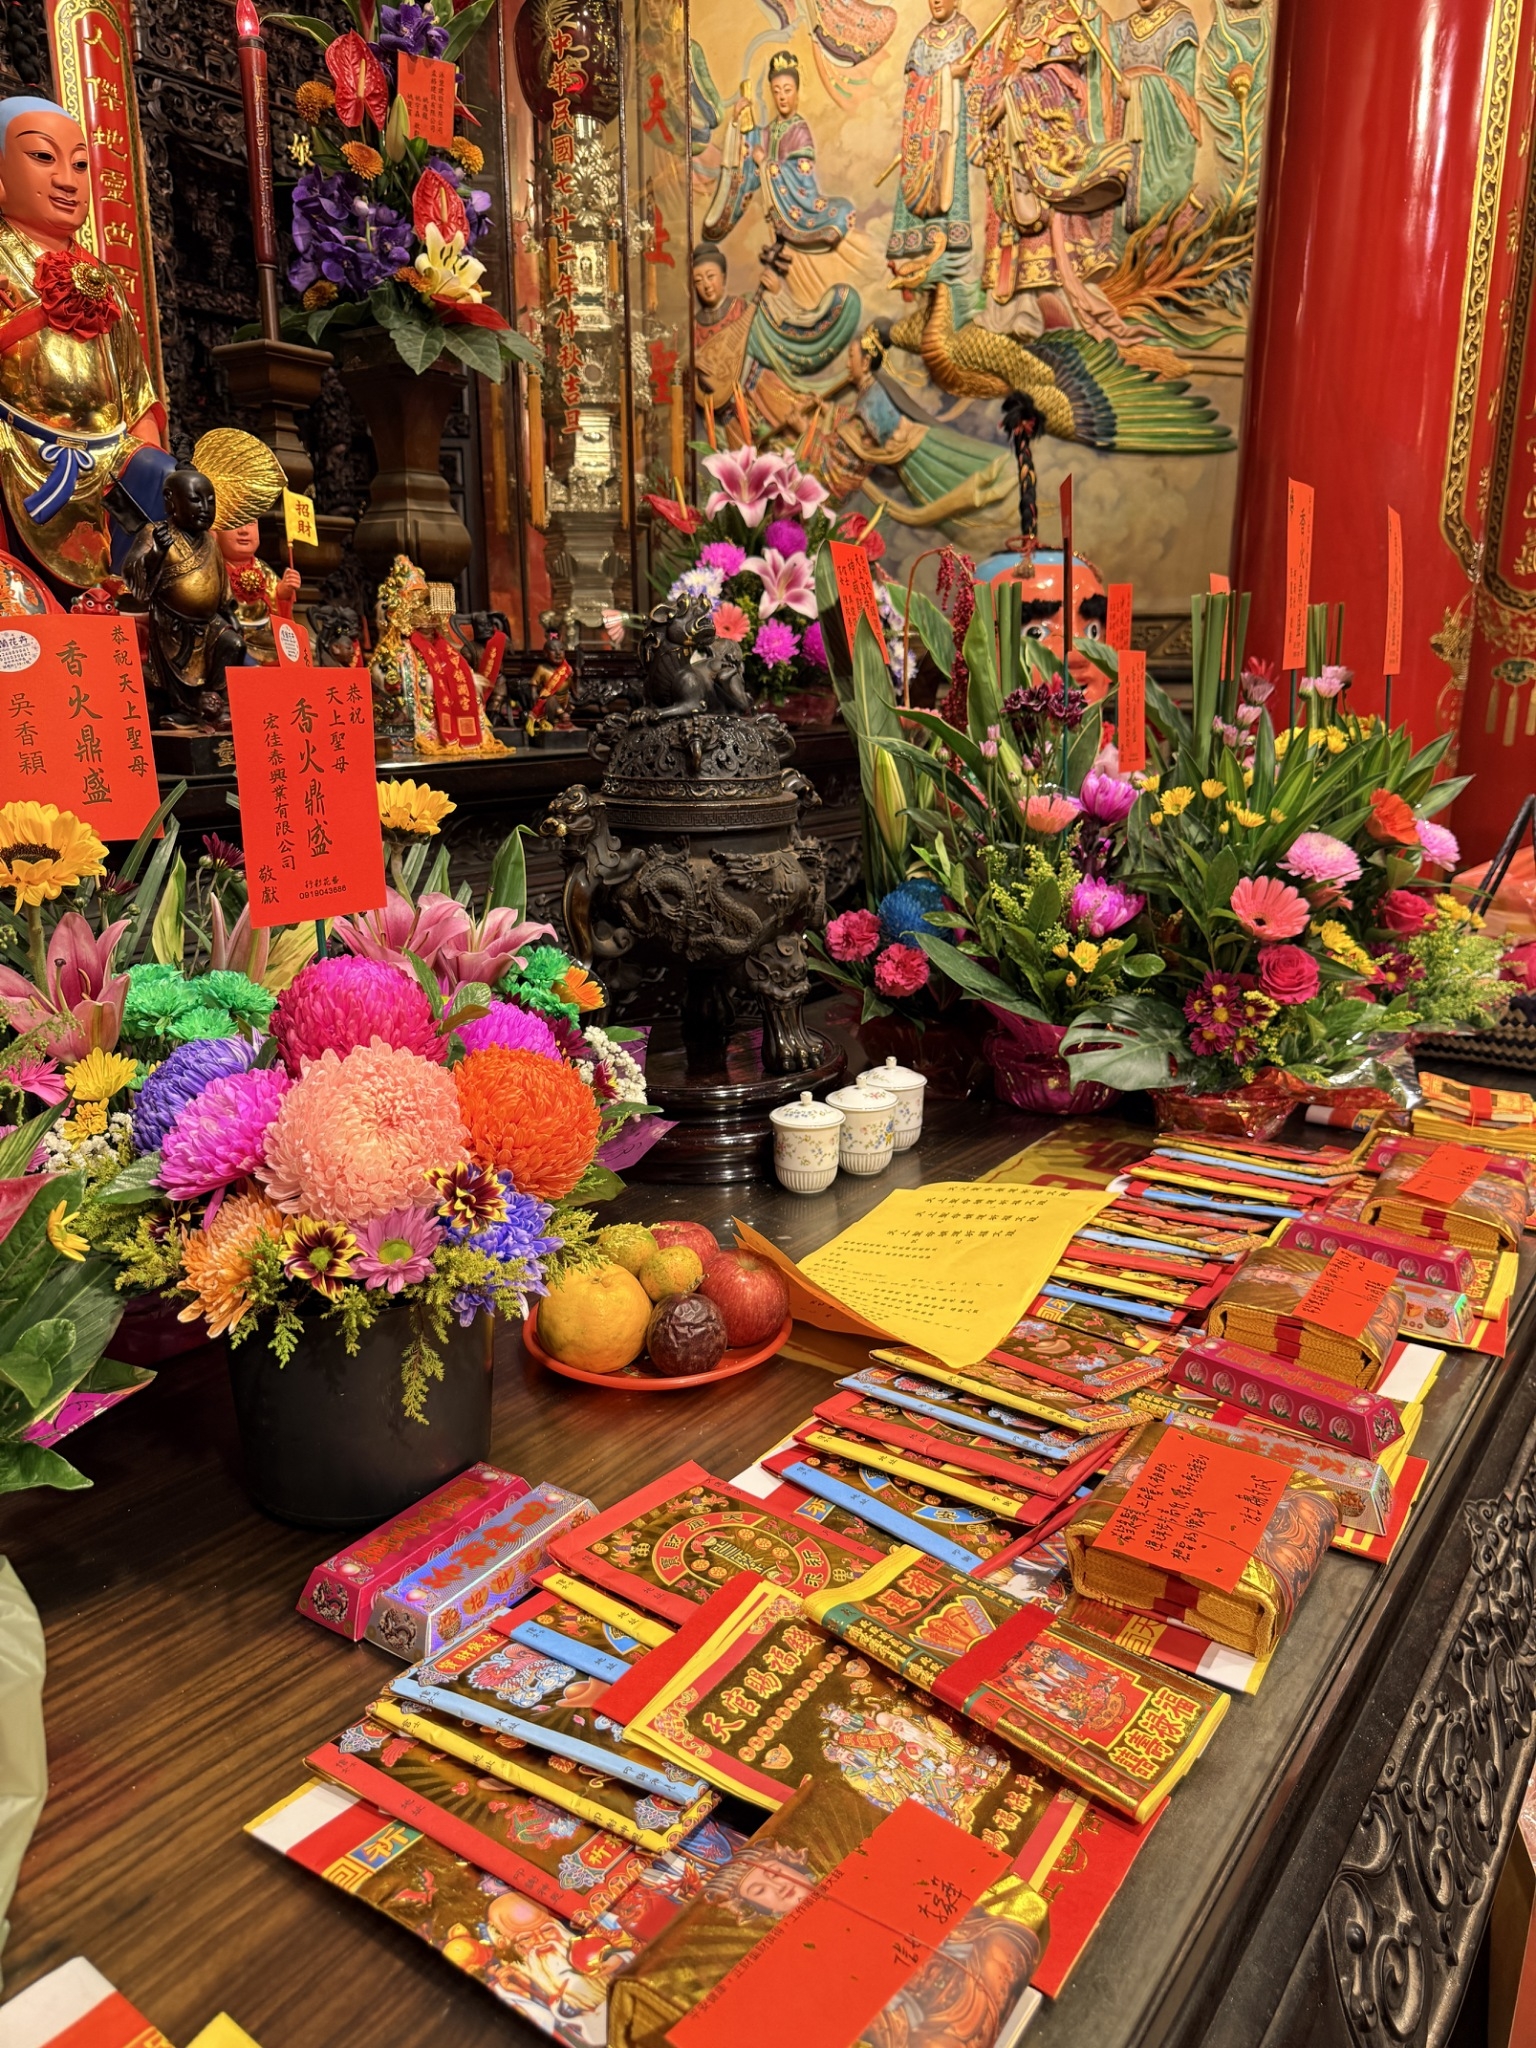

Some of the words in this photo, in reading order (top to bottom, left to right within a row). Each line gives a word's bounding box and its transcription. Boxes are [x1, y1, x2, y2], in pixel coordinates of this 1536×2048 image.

[547, 28, 584, 436] 中華民國七十二年仲秋吉旦
[295, 500, 311, 537] 招財
[56, 640, 112, 805] 香火鼎盛
[111, 625, 149, 778] 恭祝天上聖母
[346, 683, 365, 725] 恭祝
[325, 686, 349, 773] 天上聖母
[263, 713, 296, 871] 宏佳泰興業有限公司
[290, 697, 333, 858] 香火鼎盛
[258, 864, 280, 904] 敬獻
[616, 1610, 641, 1626] 地址
[593, 1657, 618, 1671] 地址
[702, 1624, 827, 1744] 天官賜福錢
[494, 1717, 520, 1732] 地址
[472, 1754, 497, 1772] 地址
[362, 1826, 409, 1863] 祈
